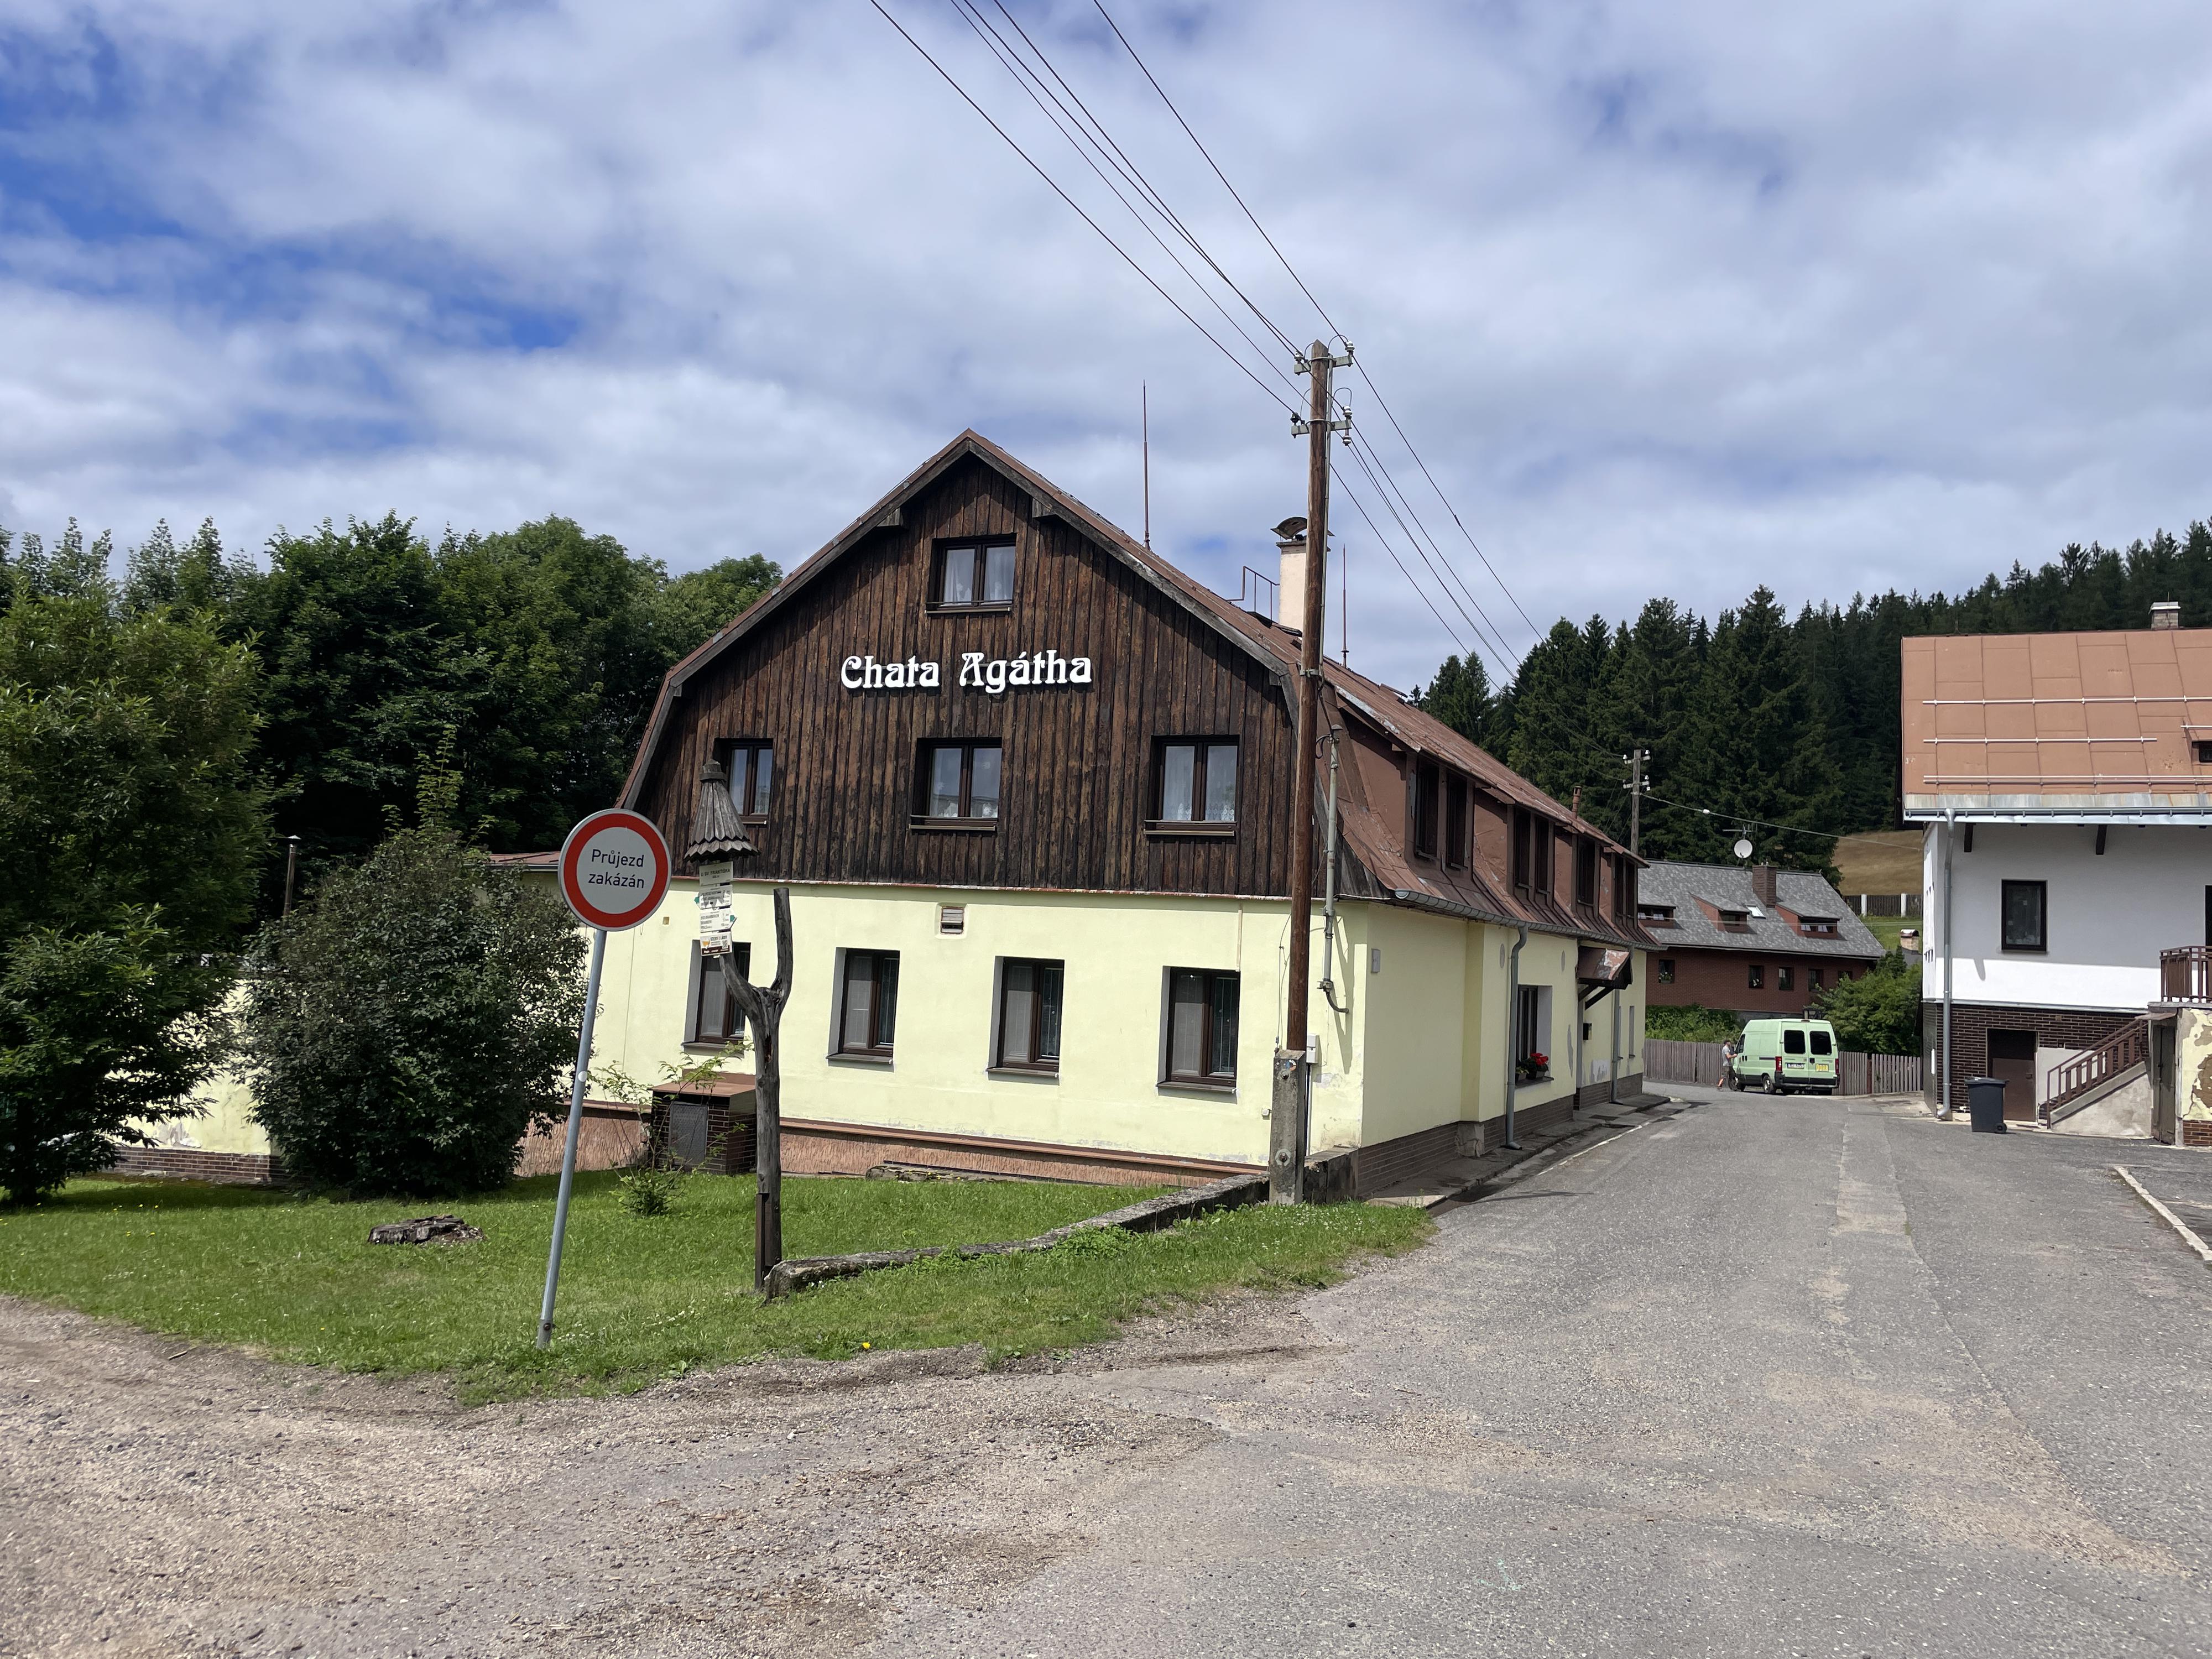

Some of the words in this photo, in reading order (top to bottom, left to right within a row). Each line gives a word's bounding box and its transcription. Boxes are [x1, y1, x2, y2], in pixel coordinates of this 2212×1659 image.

[841, 655, 940, 688] Chata
[959, 650, 1092, 693] Agátha
[591, 849, 644, 868] Průjezd
[588, 872, 645, 889] zakázán
